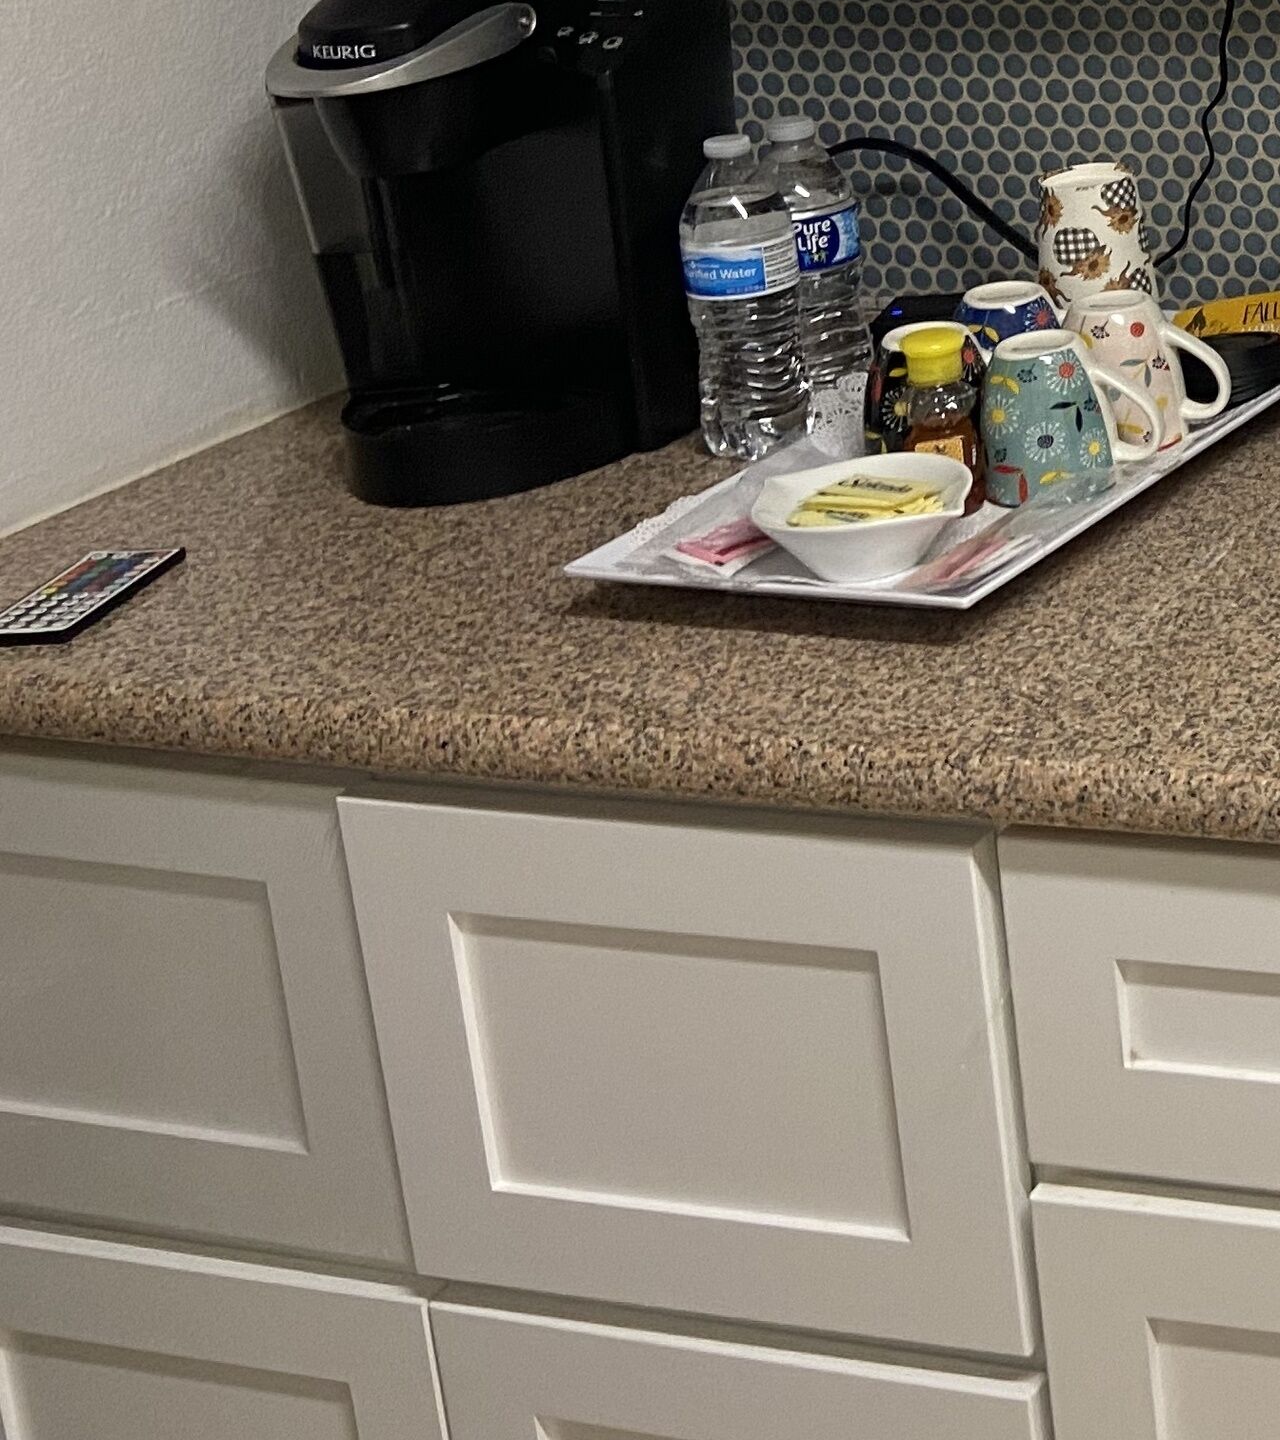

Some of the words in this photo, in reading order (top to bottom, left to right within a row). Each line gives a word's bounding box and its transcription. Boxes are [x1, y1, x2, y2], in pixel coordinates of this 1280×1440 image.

[312, 44, 377, 60] KEURIG
[793, 217, 832, 236] Pure
[797, 235, 830, 254] Life
[720, 267, 757, 280] Water
[1242, 301, 1280, 326] FALL
